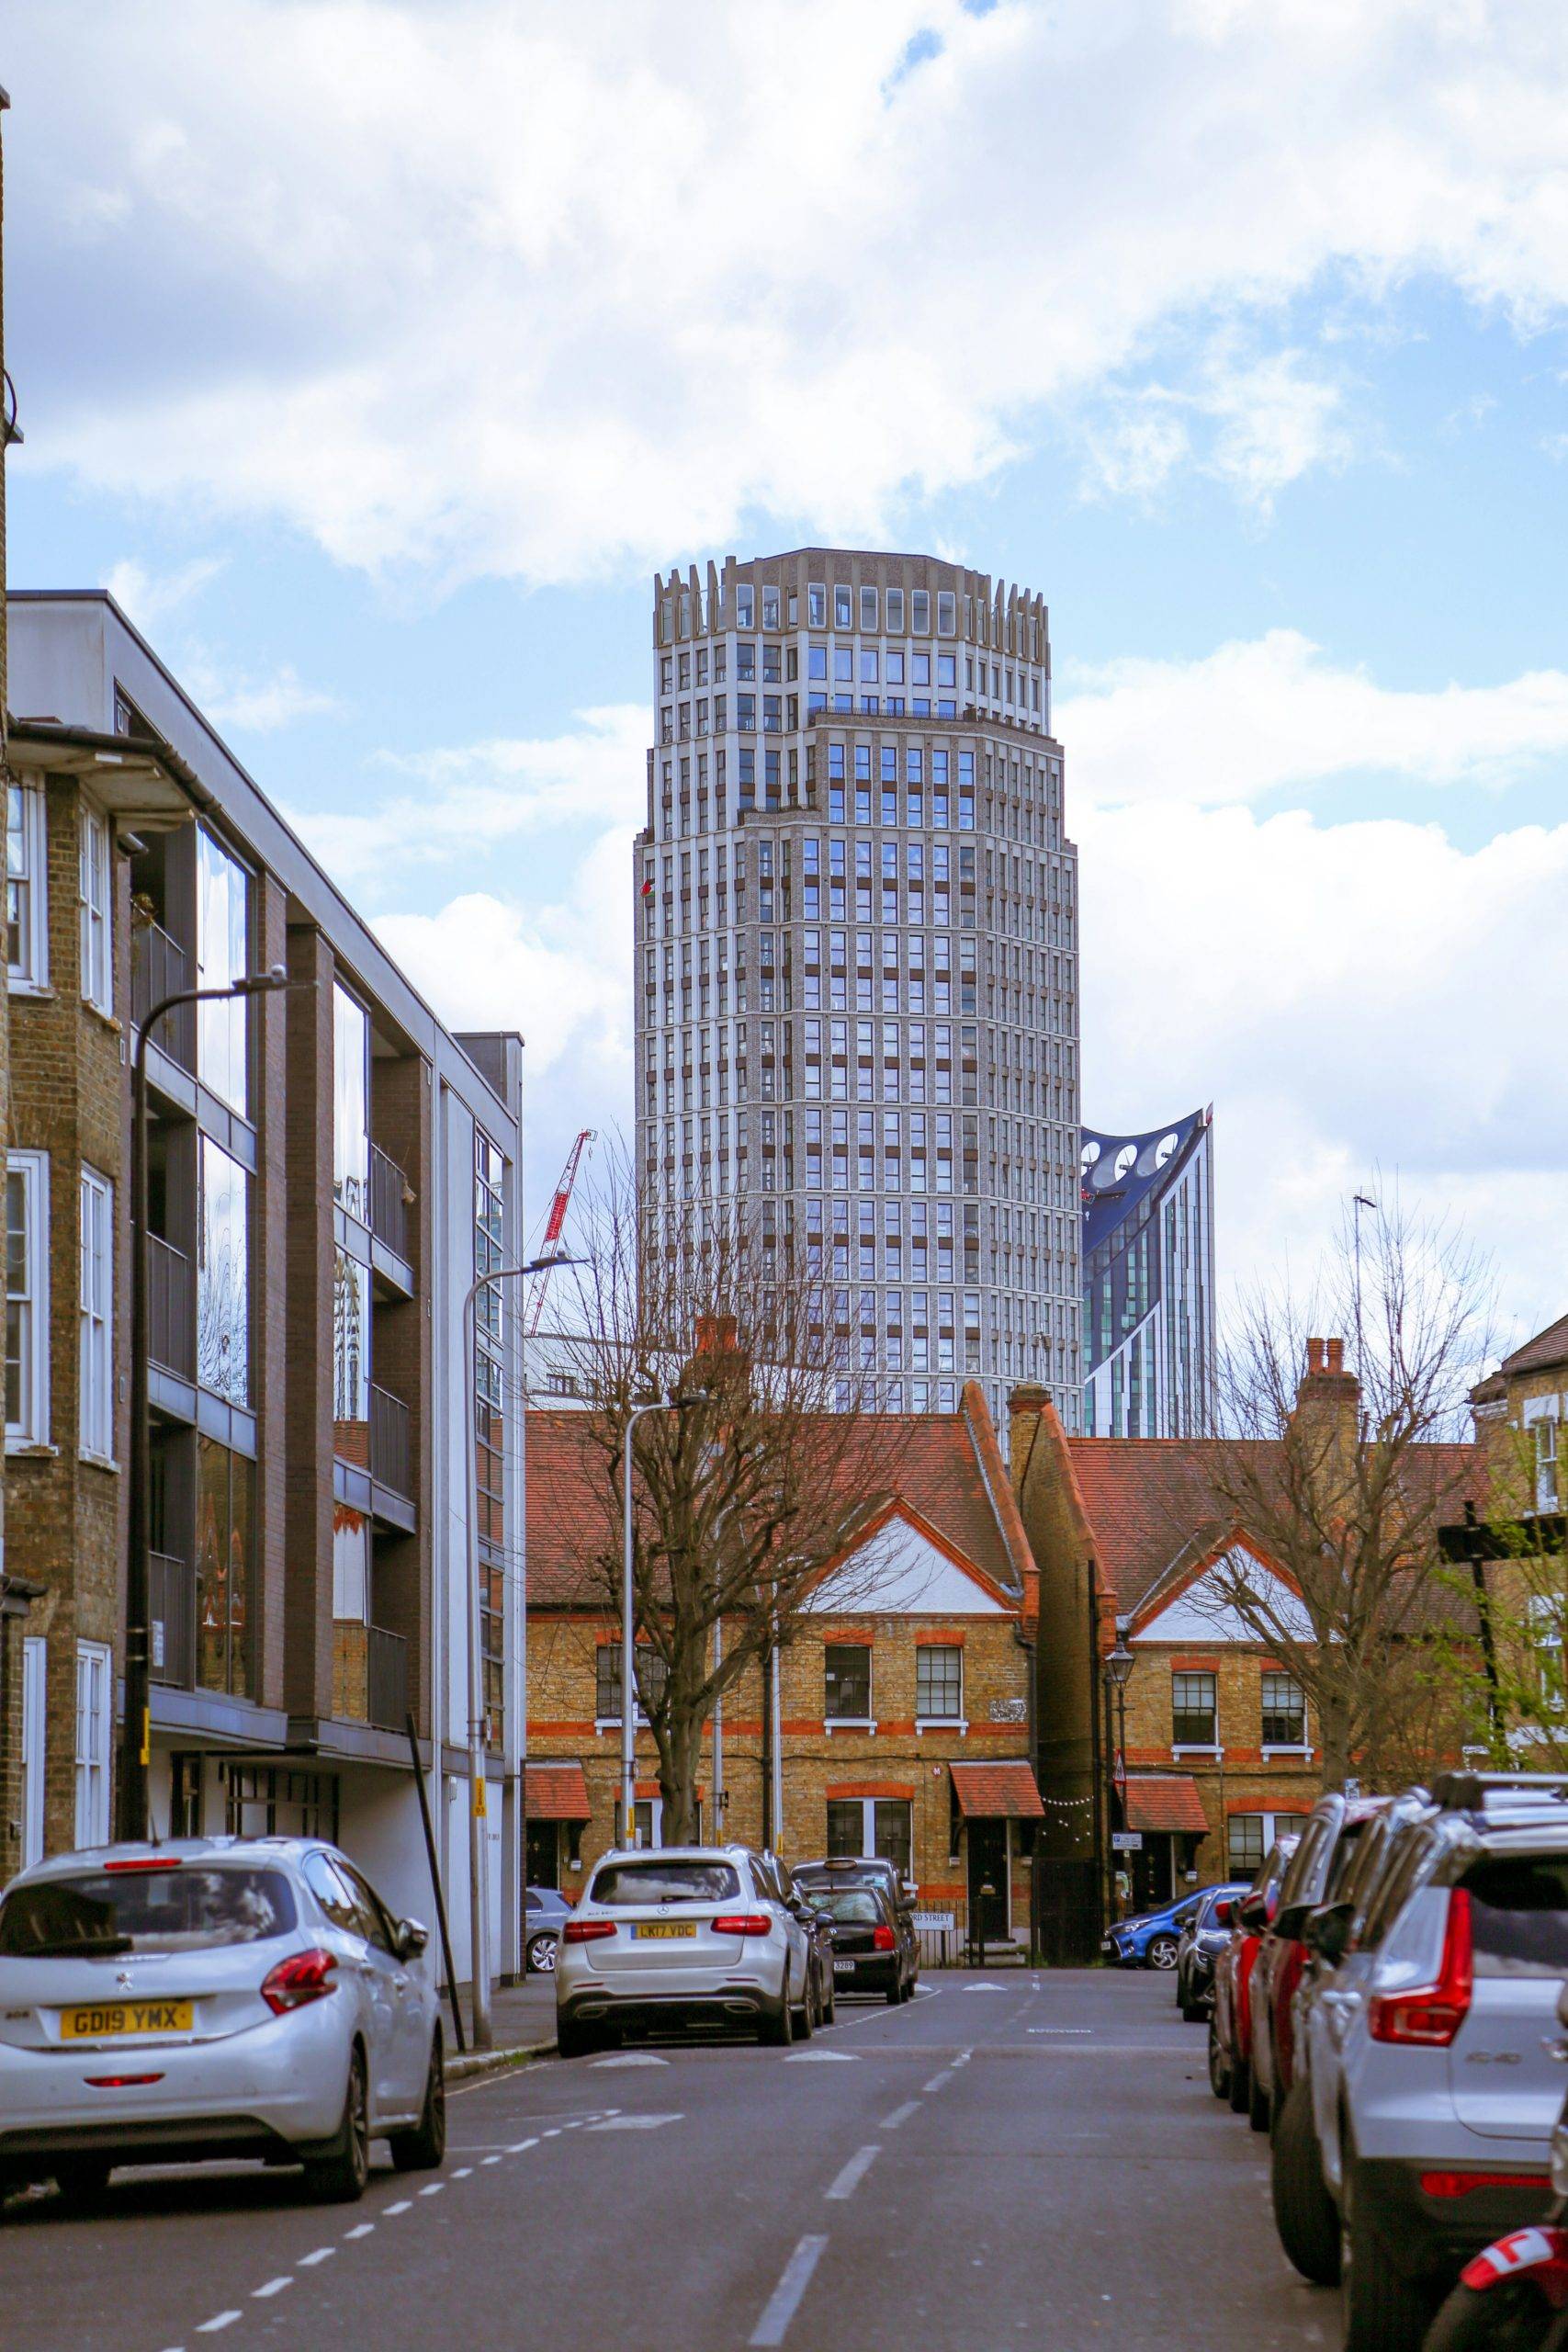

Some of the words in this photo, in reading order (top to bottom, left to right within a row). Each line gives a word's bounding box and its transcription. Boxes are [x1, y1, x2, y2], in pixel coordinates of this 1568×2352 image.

[640, 1925, 666, 1938] LK17
[74, 2008, 125, 2033] GD19
[133, 2007, 177, 2029] YMX
